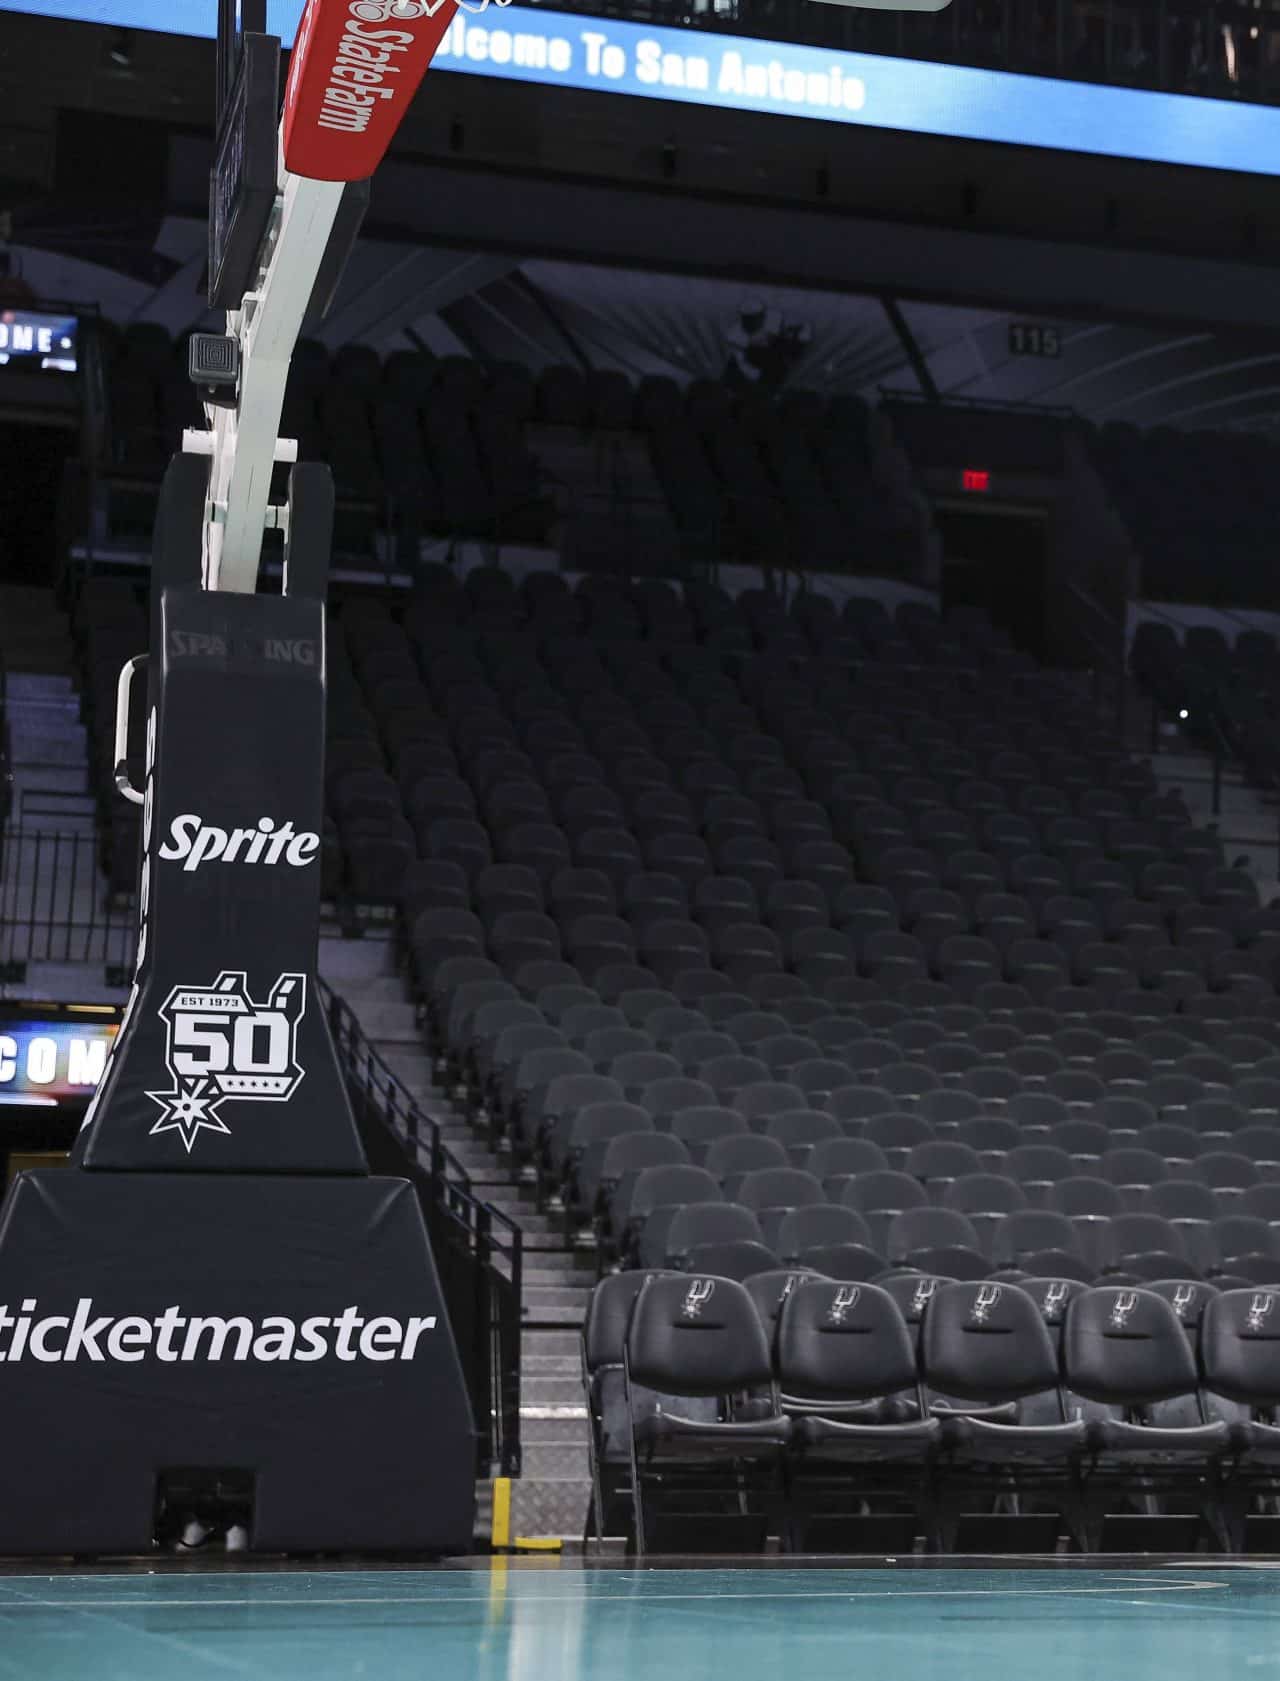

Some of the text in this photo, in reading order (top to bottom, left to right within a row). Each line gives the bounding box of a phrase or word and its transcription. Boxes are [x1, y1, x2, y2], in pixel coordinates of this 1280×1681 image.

[581, 32, 626, 79] To
[635, 38, 709, 91] San
[717, 50, 866, 111] Antonio
[1011, 326, 1059, 355] 115
[171, 630, 316, 665] SPAING
[158, 814, 320, 871] Sprite
[181, 996, 239, 1008] EST 1973
[173, 1011, 290, 1076] 50
